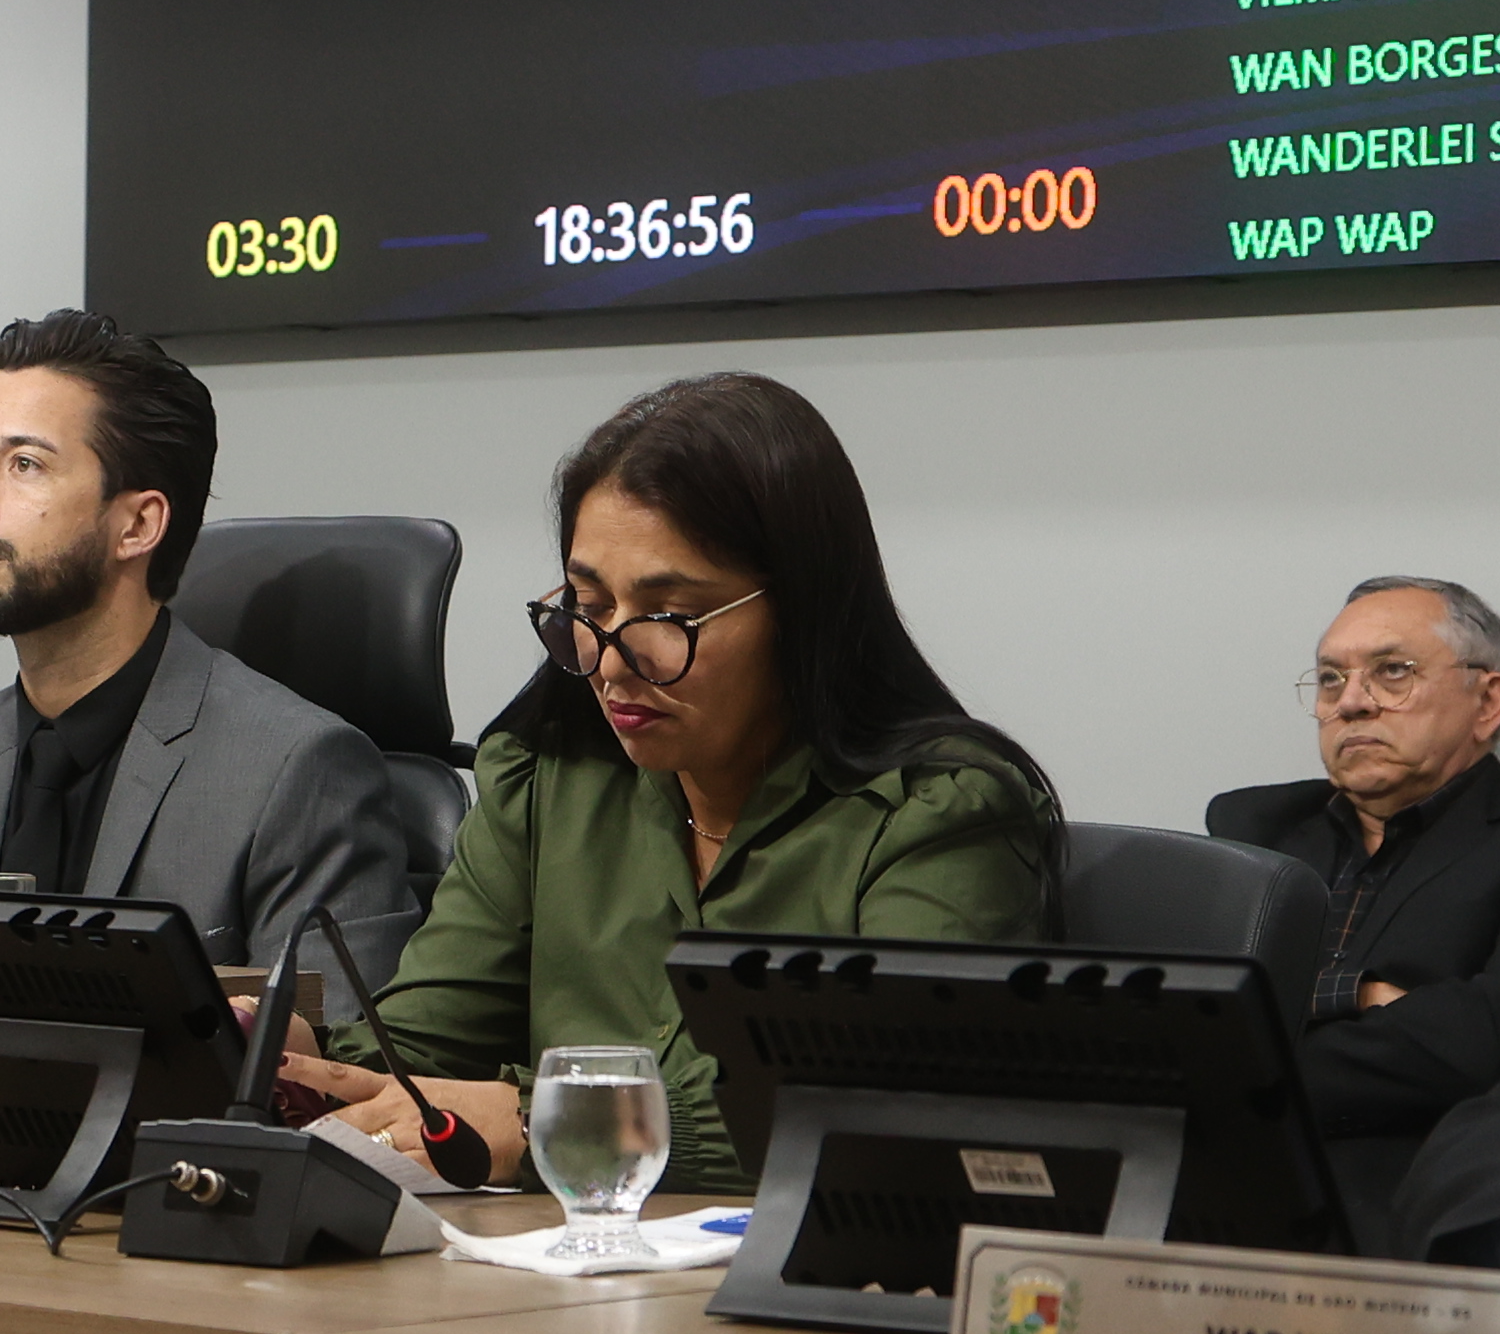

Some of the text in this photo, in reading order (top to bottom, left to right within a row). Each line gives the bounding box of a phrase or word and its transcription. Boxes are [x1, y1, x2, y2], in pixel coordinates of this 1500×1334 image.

[1229, 47, 1332, 94] WAN
[1229, 123, 1474, 179] WANDERLEI
[534, 192, 754, 266] 18:36:56
[933, 166, 1097, 237] 00:00
[207, 214, 337, 278] 03:30
[1228, 210, 1434, 261] WAP WAP
